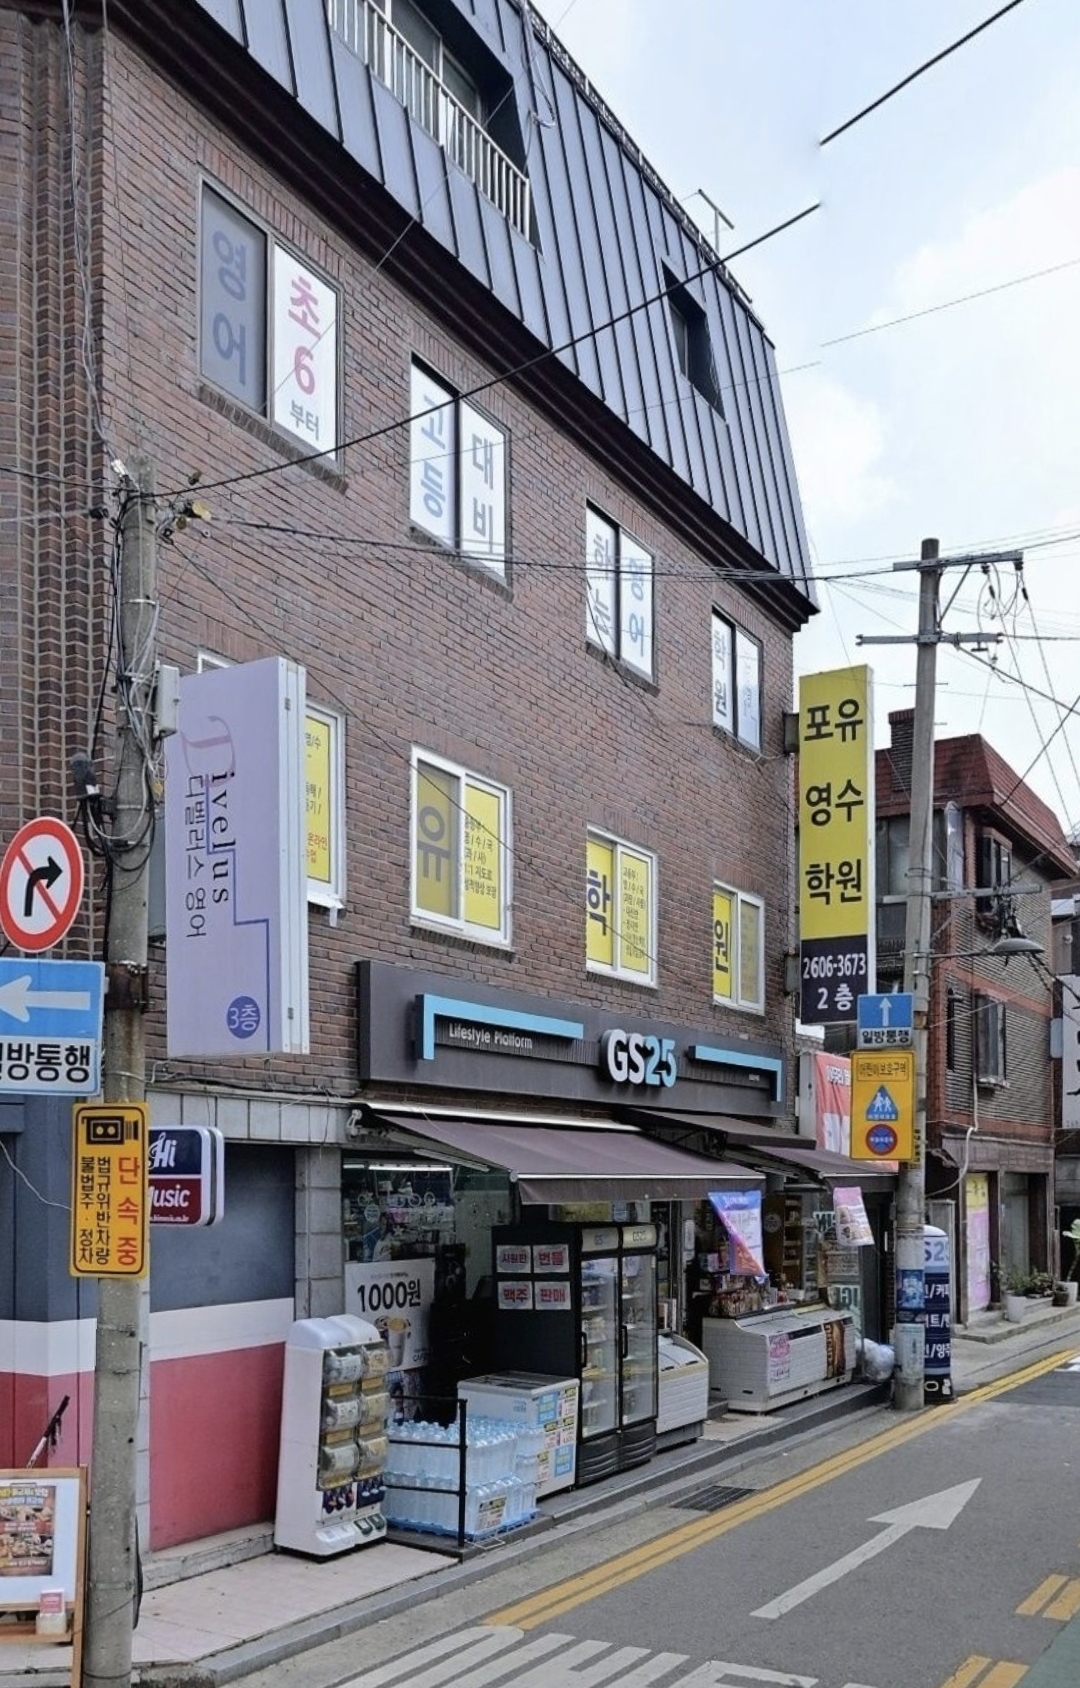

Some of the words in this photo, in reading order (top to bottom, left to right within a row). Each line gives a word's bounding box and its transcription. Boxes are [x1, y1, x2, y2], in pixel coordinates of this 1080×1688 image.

[212, 229, 247, 387] 영어
[288, 275, 322, 396] 초6
[289, 402, 320, 442] 부터
[420, 394, 446, 519] 고등
[471, 432, 495, 554] 대비
[713, 630, 727, 718] 학원
[803, 698, 864, 742] 포유
[805, 779, 864, 827] 영수
[419, 805, 450, 883] 유
[587, 869, 611, 937] 학
[805, 859, 863, 906] 학원
[184, 885, 207, 938] 영어
[714, 919, 729, 974] 원
[803, 952, 867, 980] 2606-3673
[228, 1004, 261, 1032] 3층
[817, 988, 829, 1009] 2
[834, 984, 854, 1011] 층
[448, 1022, 491, 1045] Lifestyle
[493, 1029, 534, 1050] Platform
[606, 1029, 677, 1089] GS25
[862, 1032, 910, 1044] 일방통행
[148, 1132, 177, 1170] Hi
[96, 1156, 111, 1265] 법규위반차량
[501, 1251, 527, 1264] 시원한
[357, 1278, 421, 1313] 1000원
[503, 1287, 528, 1303] 맥주
